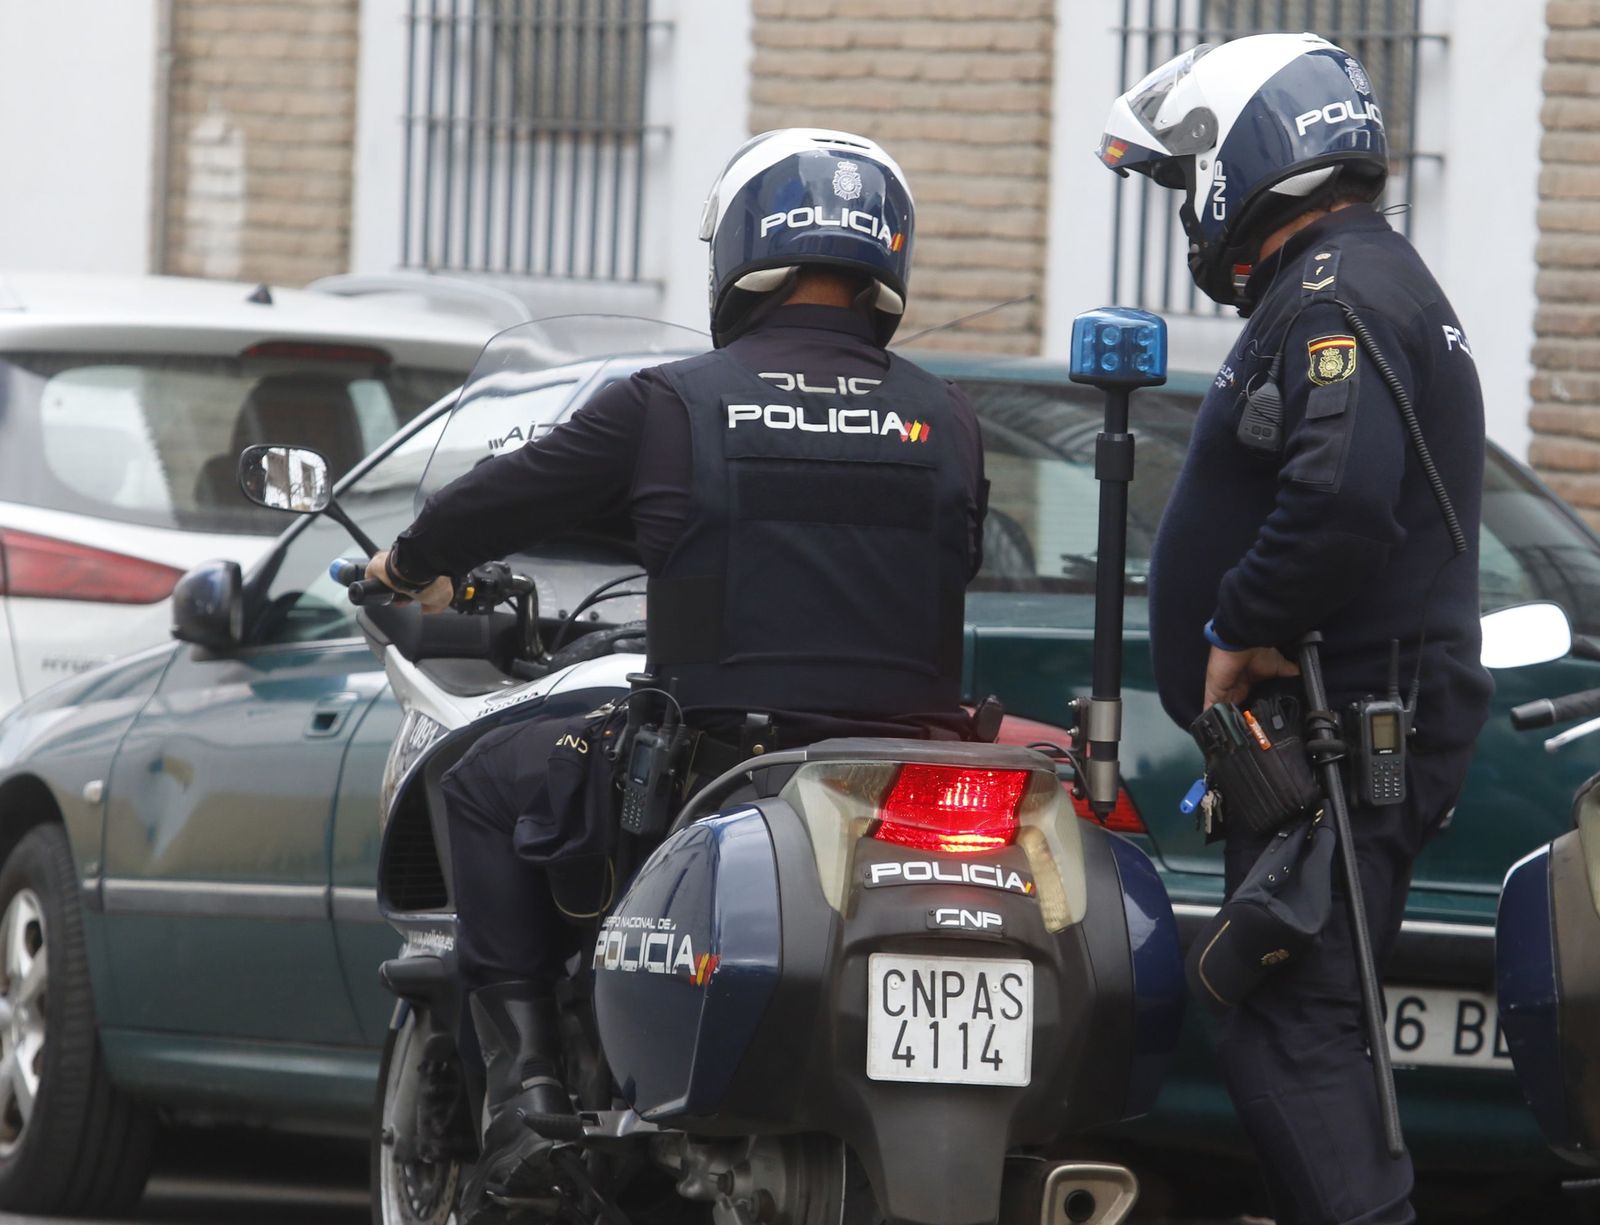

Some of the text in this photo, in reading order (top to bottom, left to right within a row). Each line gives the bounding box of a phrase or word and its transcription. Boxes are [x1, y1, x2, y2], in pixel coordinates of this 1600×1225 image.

[1213, 160, 1227, 221] CNP
[760, 205, 894, 249] POLICIA
[727, 404, 908, 436] POLICIA
[657, 918, 672, 930] DE
[936, 908, 1003, 928] CNP
[883, 968, 1023, 1021] CNPAS
[892, 1019, 1003, 1071] 4114
